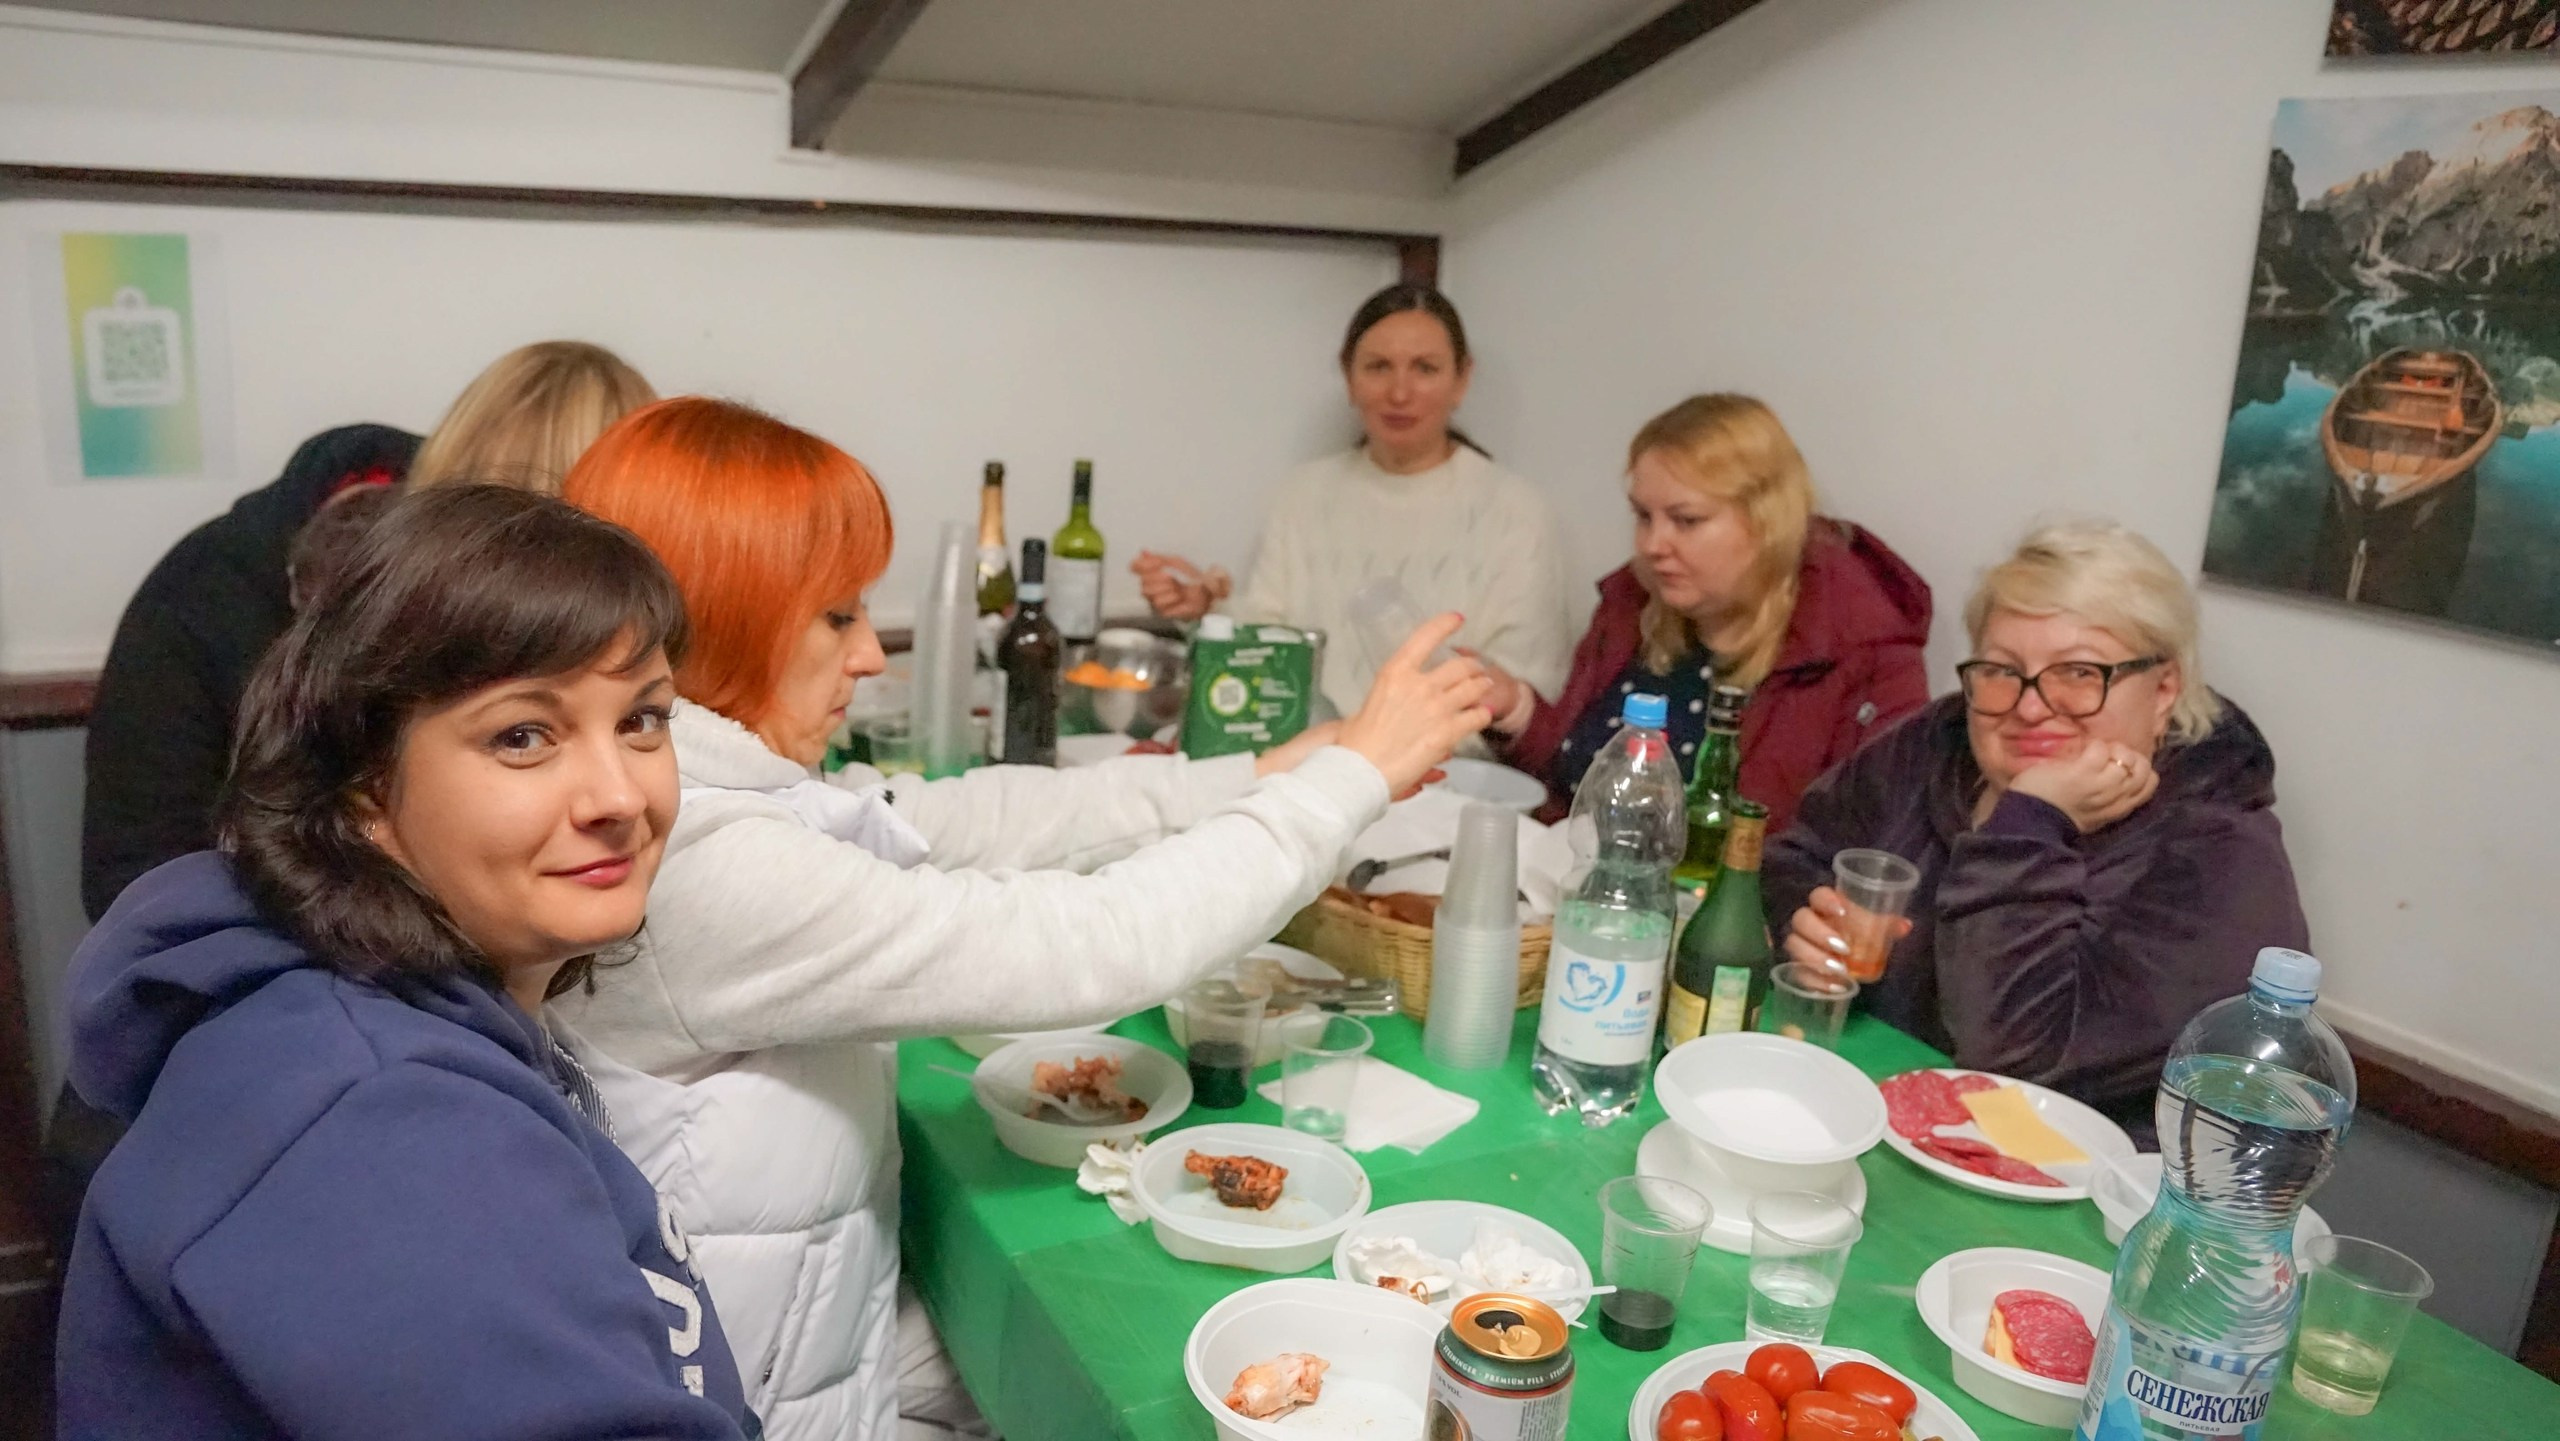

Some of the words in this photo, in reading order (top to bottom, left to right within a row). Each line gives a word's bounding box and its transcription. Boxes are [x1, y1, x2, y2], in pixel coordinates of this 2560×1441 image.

[1443, 1345, 1477, 1376] STEININGER
[1483, 1372, 1525, 1385] PREMIUM
[1527, 1376, 1544, 1385] PILS
[2127, 1369, 2270, 1423] СЕНЕЖСКАЯ
